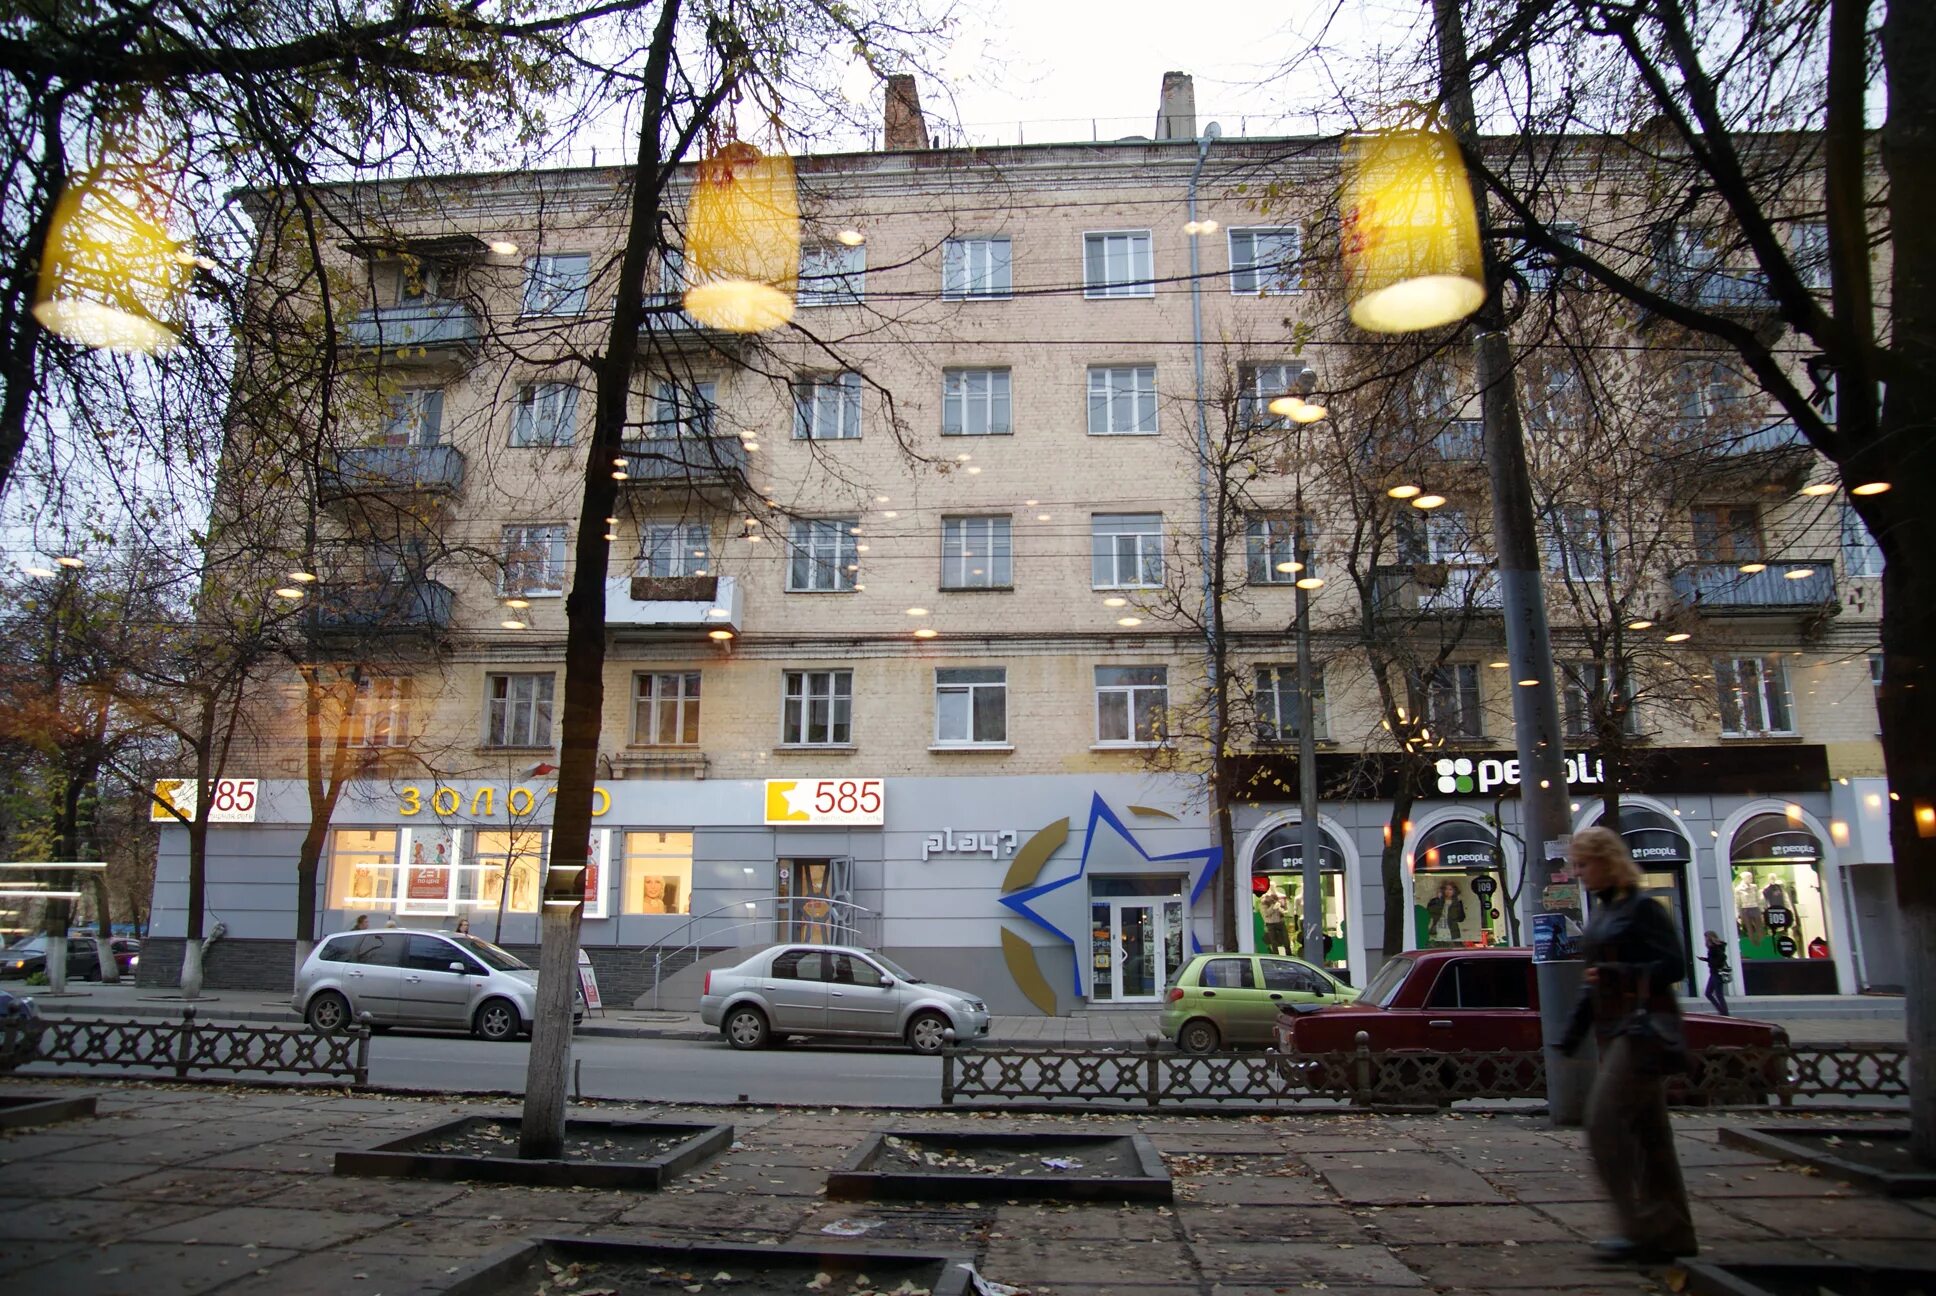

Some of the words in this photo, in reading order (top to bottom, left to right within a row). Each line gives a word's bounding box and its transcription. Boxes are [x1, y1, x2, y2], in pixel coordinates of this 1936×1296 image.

[1478, 753, 1604, 793] pel
[207, 781, 254, 812] 85
[399, 786, 612, 816] ЗОЛОО
[815, 781, 881, 814] 585
[922, 826, 1017, 861] play?
[1643, 847, 1677, 857] people
[1782, 844, 1815, 854] people
[1292, 857, 1326, 866] pee
[1457, 853, 1490, 863] people
[418, 867, 441, 879] 2=1
